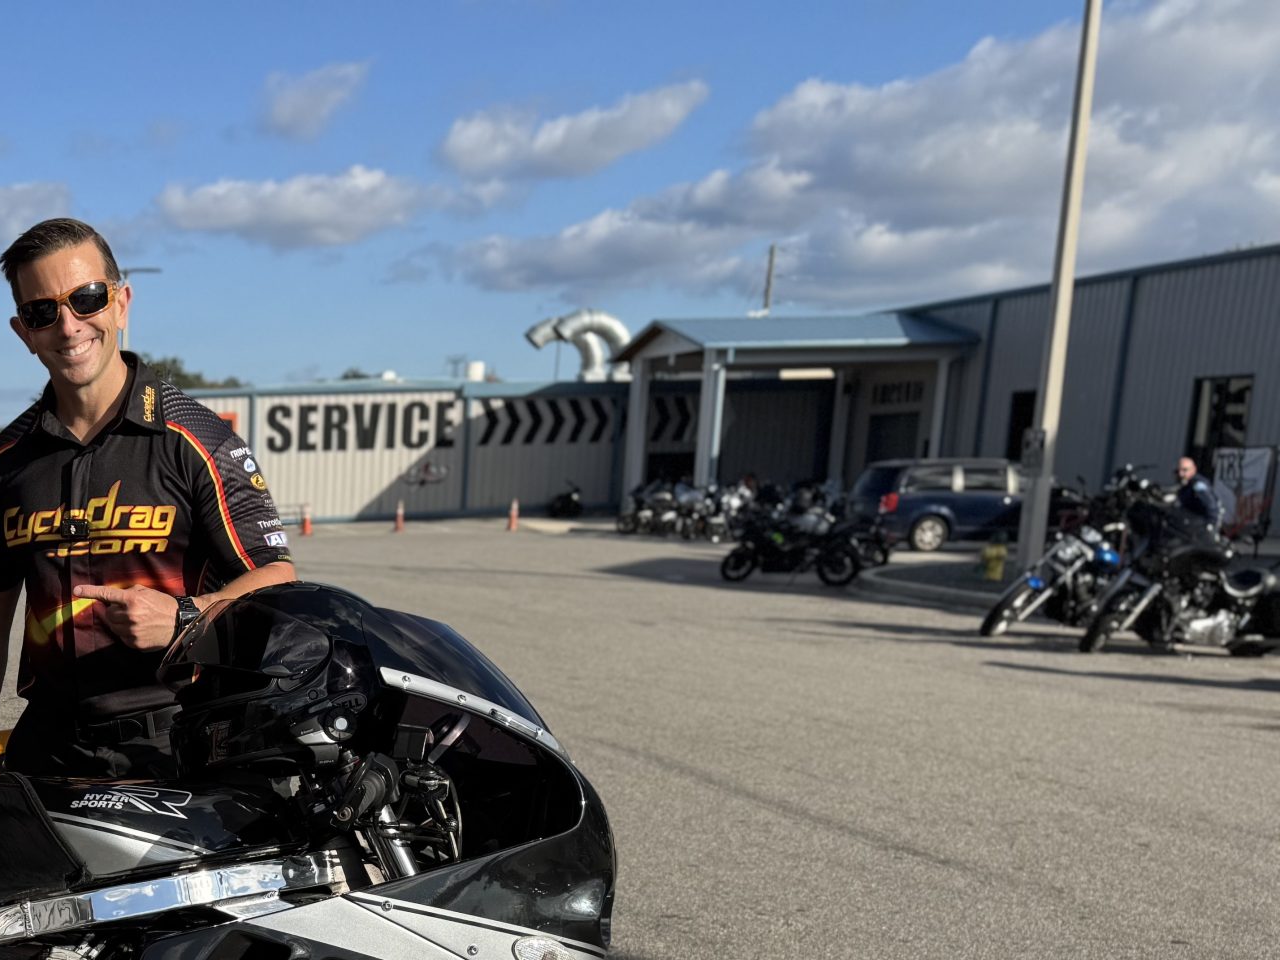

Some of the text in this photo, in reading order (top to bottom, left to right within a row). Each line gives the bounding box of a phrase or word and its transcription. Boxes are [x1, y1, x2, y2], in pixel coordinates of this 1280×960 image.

[266, 401, 456, 454] SERVICE
[46, 538, 169, 558] .com
[70, 800, 124, 810] SPORTS
[83, 793, 130, 803] HYPER
